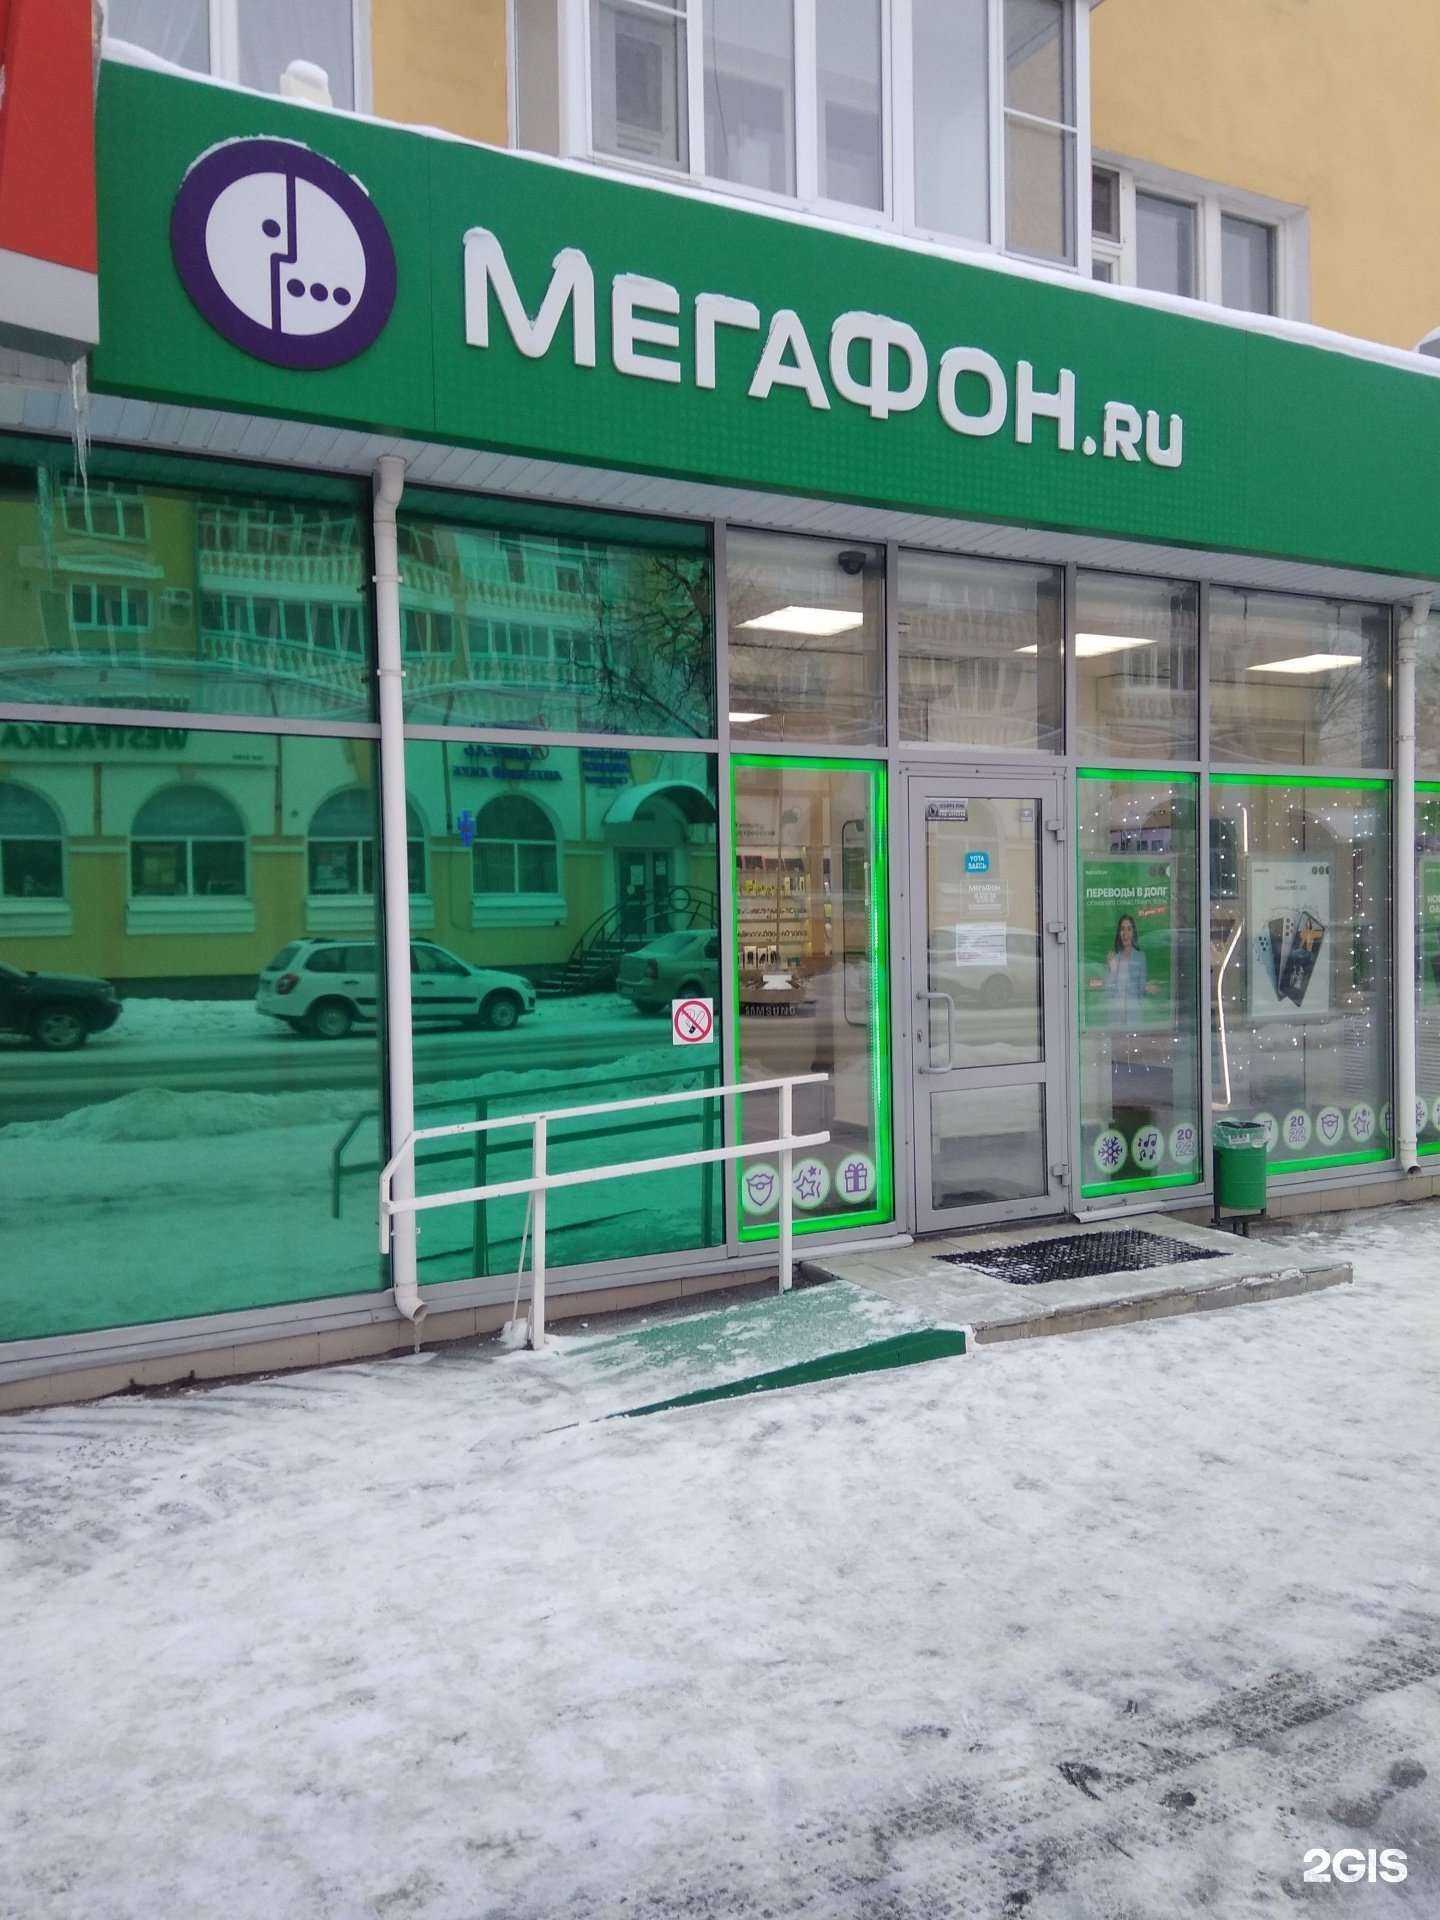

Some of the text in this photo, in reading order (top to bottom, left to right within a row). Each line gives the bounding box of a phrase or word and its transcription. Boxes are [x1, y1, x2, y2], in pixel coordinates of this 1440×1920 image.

[463, 226, 1185, 468] МЕГАФОН.RU
[1086, 886, 1168, 898] ПЕРЕВОДЫ В ДОЛГ
[1290, 1115, 1304, 1128] 20
[1177, 1128, 1193, 1141] 20
